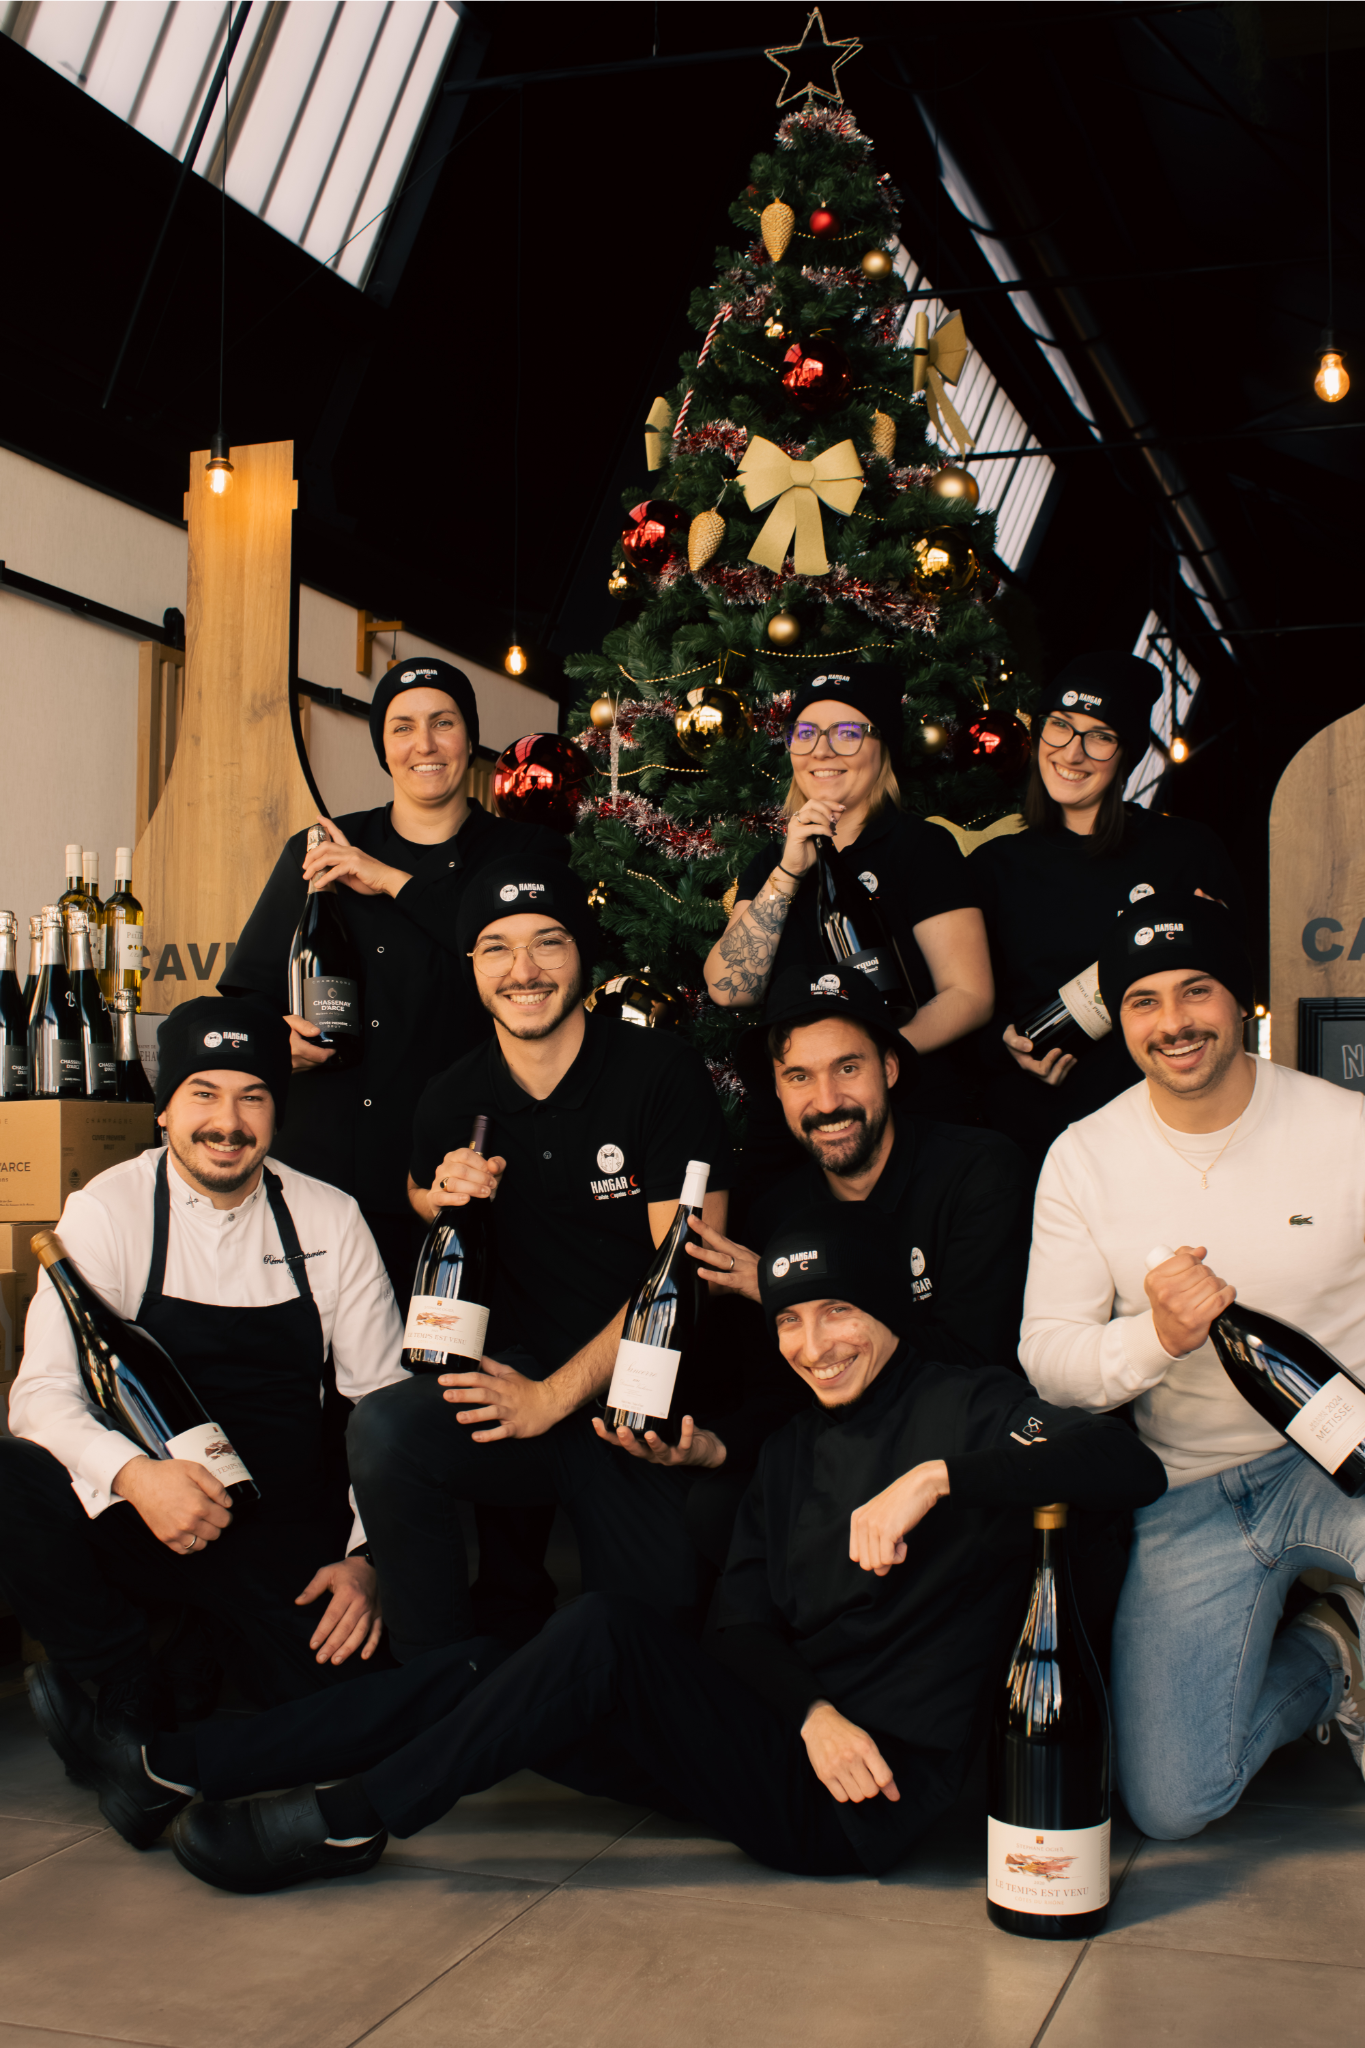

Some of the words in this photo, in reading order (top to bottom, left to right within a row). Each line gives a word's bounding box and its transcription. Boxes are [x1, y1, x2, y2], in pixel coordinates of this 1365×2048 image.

[1078, 693, 1102, 706] HANGAR
[1084, 703, 1092, 711] C
[518, 883, 545, 892] HANGAR
[1154, 923, 1184, 932] HANGAR
[1165, 931, 1175, 940] C
[223, 1032, 248, 1042] HANGAR
[232, 1040, 240, 1048] C
[590, 1176, 628, 1194] HANGAR
[790, 1250, 818, 1264] HANGAR
[800, 1261, 809, 1271] C
[449, 1336, 466, 1345] VENU
[1325, 1395, 1343, 1412] 2024
[216, 1463, 237, 1474] TEMPS
[1016, 1842, 1043, 1851] STEPHANE
[995, 1878, 1003, 1888] LE
[1005, 1882, 1037, 1895] TEMPS
[1040, 1888, 1060, 1897] EST
[1063, 1886, 1088, 1896] VENU
[1014, 1895, 1031, 1903] CÔTES
